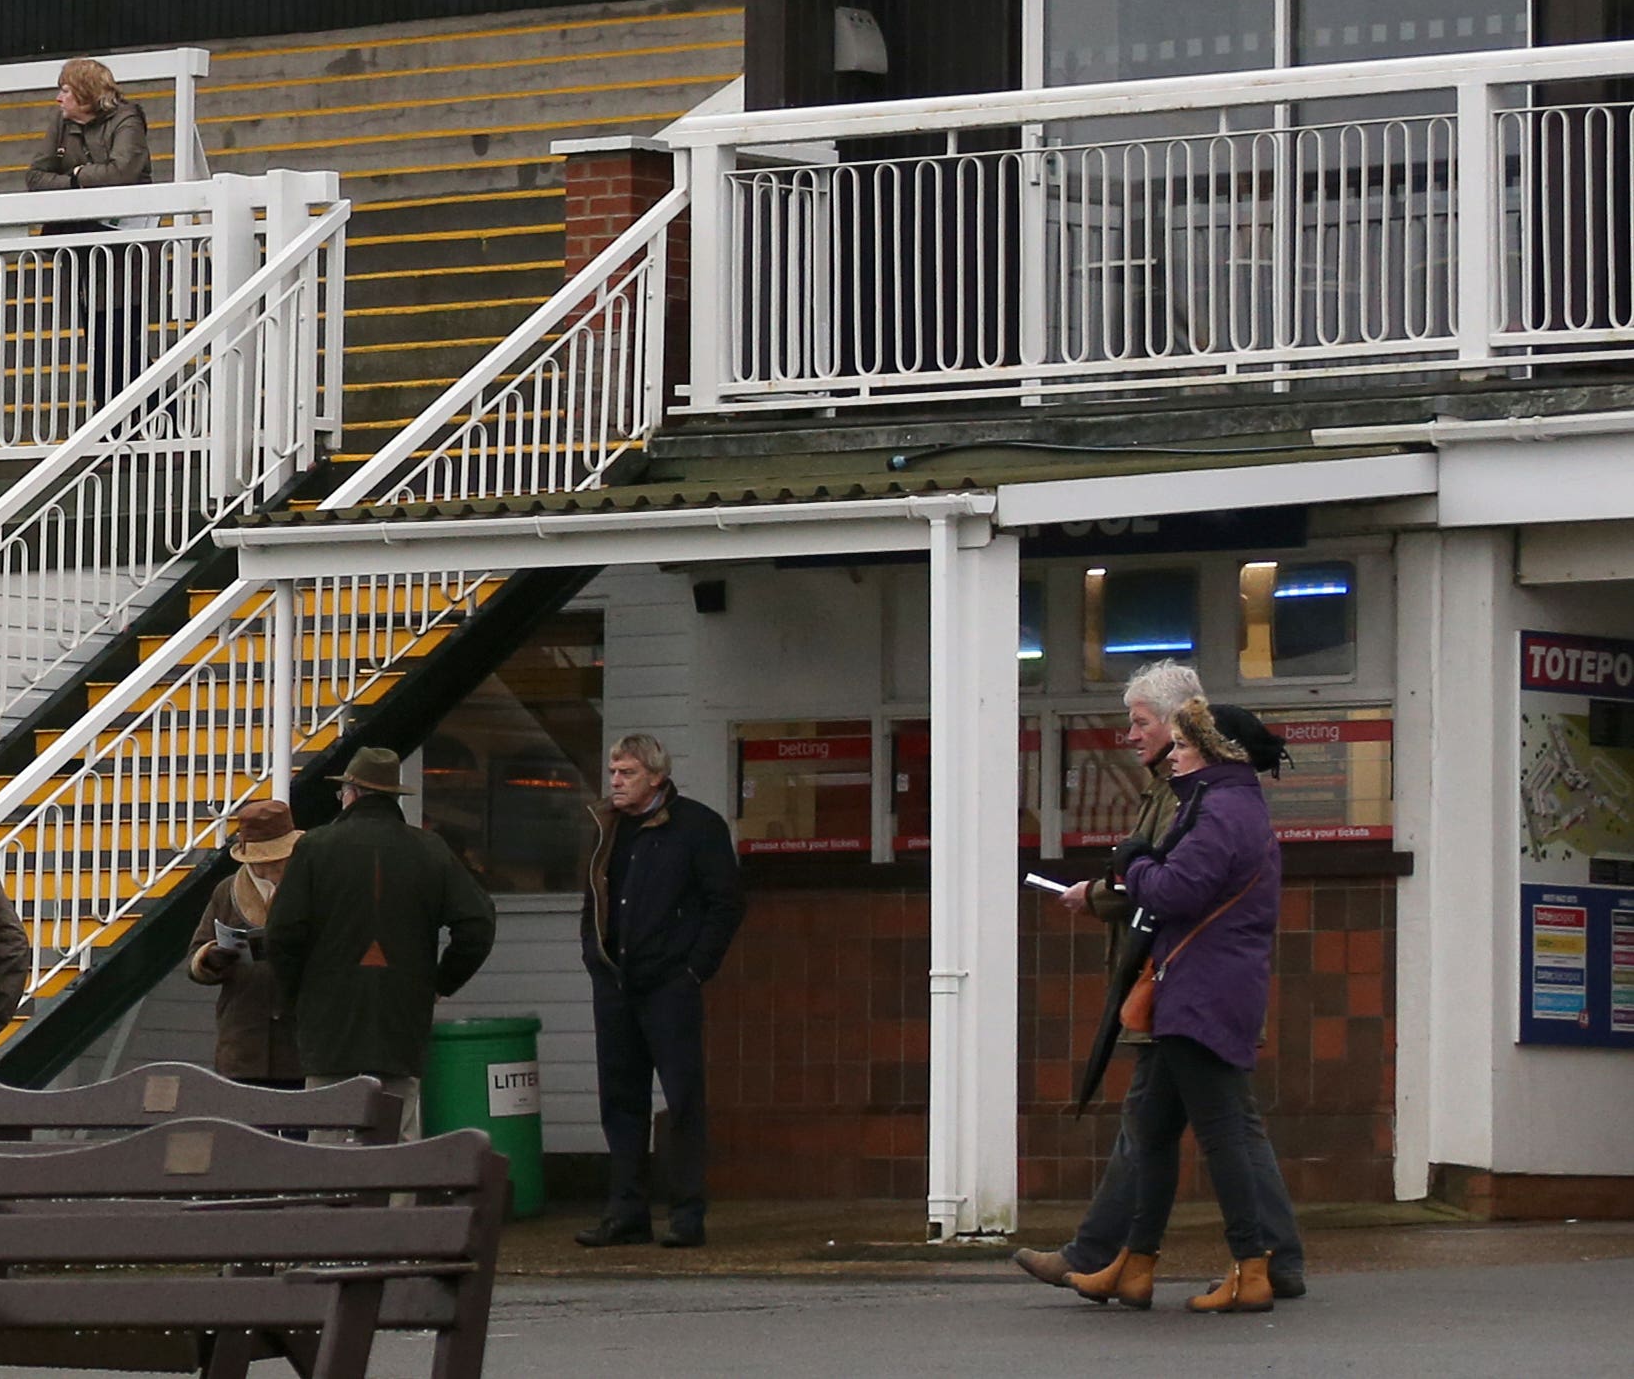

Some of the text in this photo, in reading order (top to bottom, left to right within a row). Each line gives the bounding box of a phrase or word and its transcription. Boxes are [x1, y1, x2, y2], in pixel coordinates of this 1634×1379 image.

[1285, 724, 1339, 741] betting
[778, 740, 829, 758] betting
[1082, 833, 1112, 844] please
[1284, 828, 1312, 839] check
[1314, 829, 1337, 839] your
[1338, 827, 1370, 837] tickets
[750, 837, 860, 852] please check your tickets
